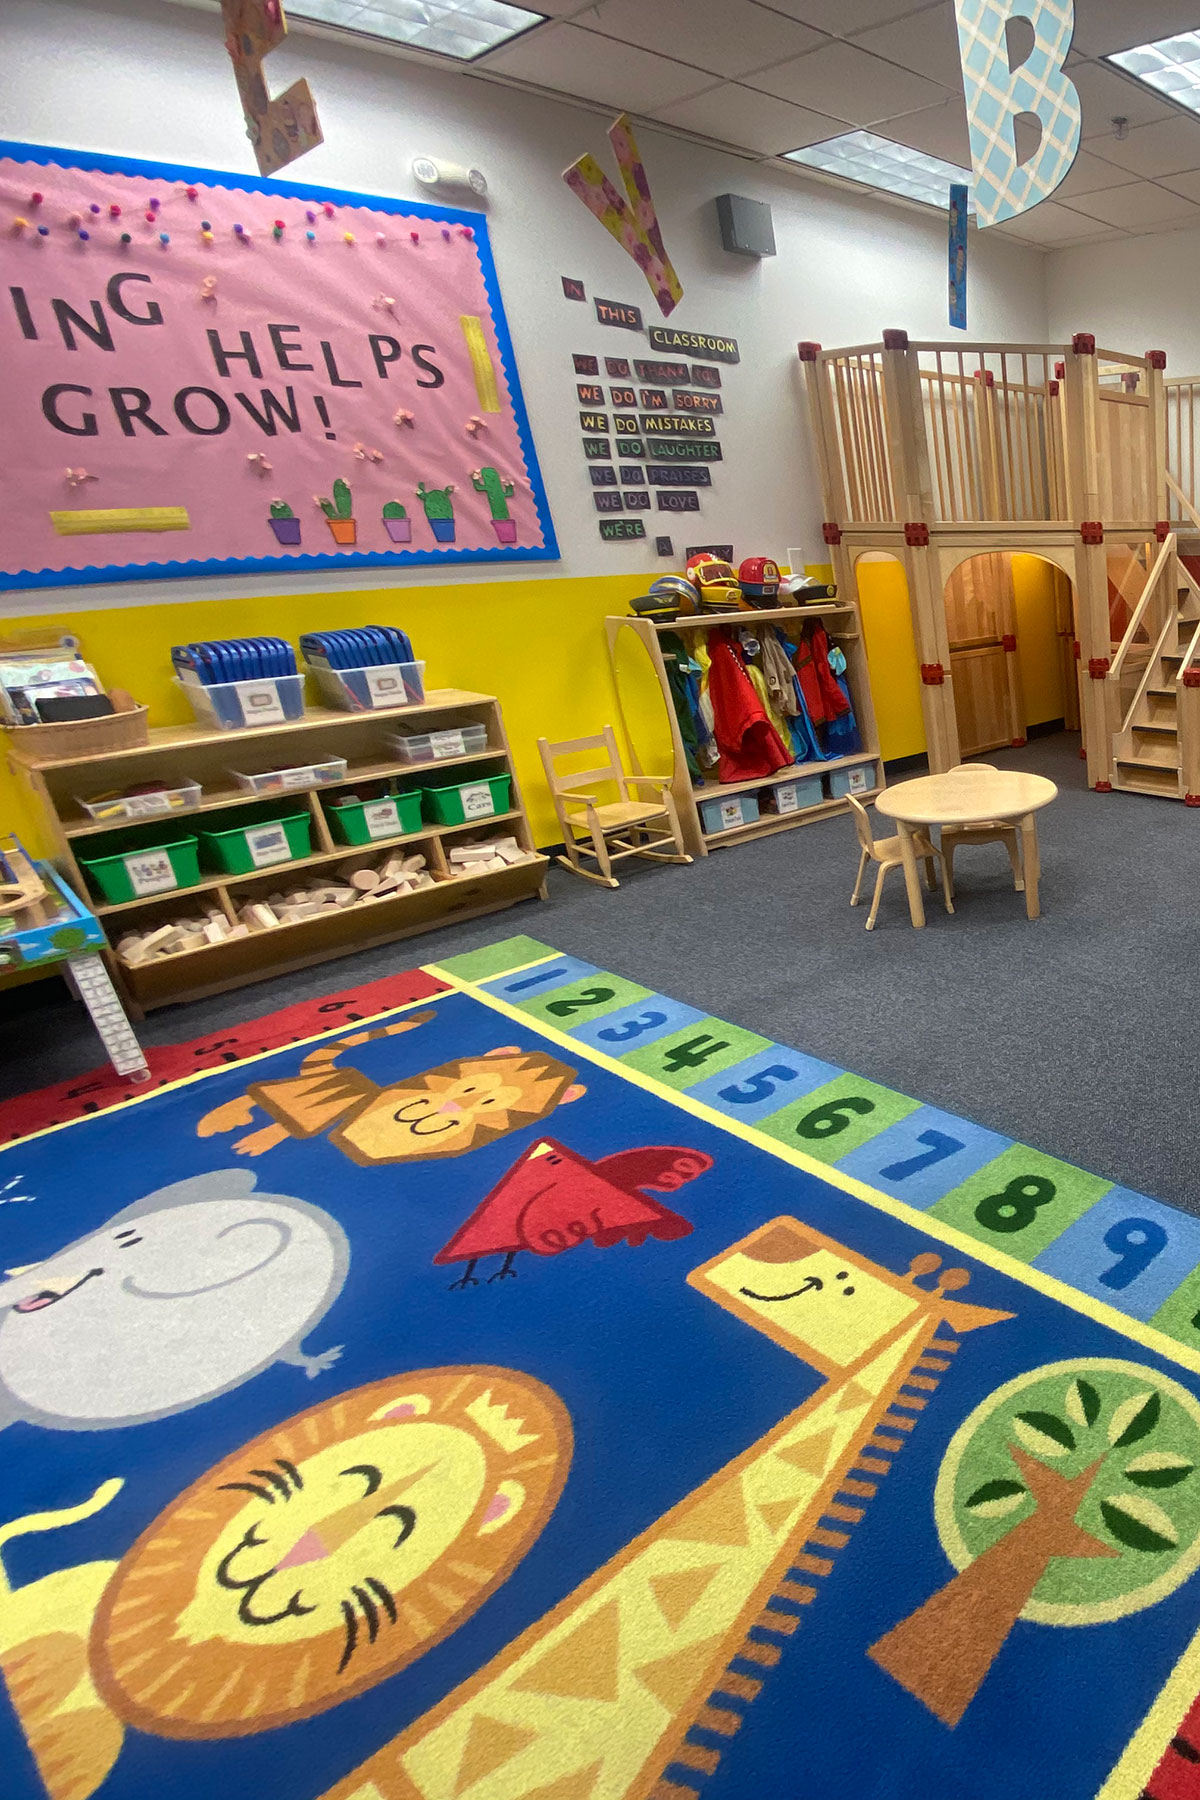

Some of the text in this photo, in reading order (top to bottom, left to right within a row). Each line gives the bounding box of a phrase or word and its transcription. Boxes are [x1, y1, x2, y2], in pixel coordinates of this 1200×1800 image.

[955, 0, 1082, 230] B
[9, 272, 445, 389] ING HELPS
[598, 305, 637, 324] THIS
[653, 330, 737, 353] CLASSROOM
[575, 358, 595, 372] WE
[579, 387, 718, 409] WE DO I'M SORRY
[41, 382, 337, 440] GROW!
[582, 415, 713, 432] WE DO MISTAKES
[585, 442, 719, 457] WE DO LAUGHTER
[592, 467, 709, 482] WE DO PRAISES
[599, 494, 697, 508] WE DO LOVE
[602, 520, 644, 537] WE'RE
[467, 801, 491, 811] Cars
[545, 987, 616, 1017] 2
[597, 1011, 668, 1042] 3
[662, 1034, 731, 1072] 4
[717, 1064, 799, 1105] 5
[796, 1096, 876, 1139] 6
[879, 1129, 966, 1181] 7
[975, 1175, 1056, 1232] 8
[1098, 1217, 1168, 1290] 9
